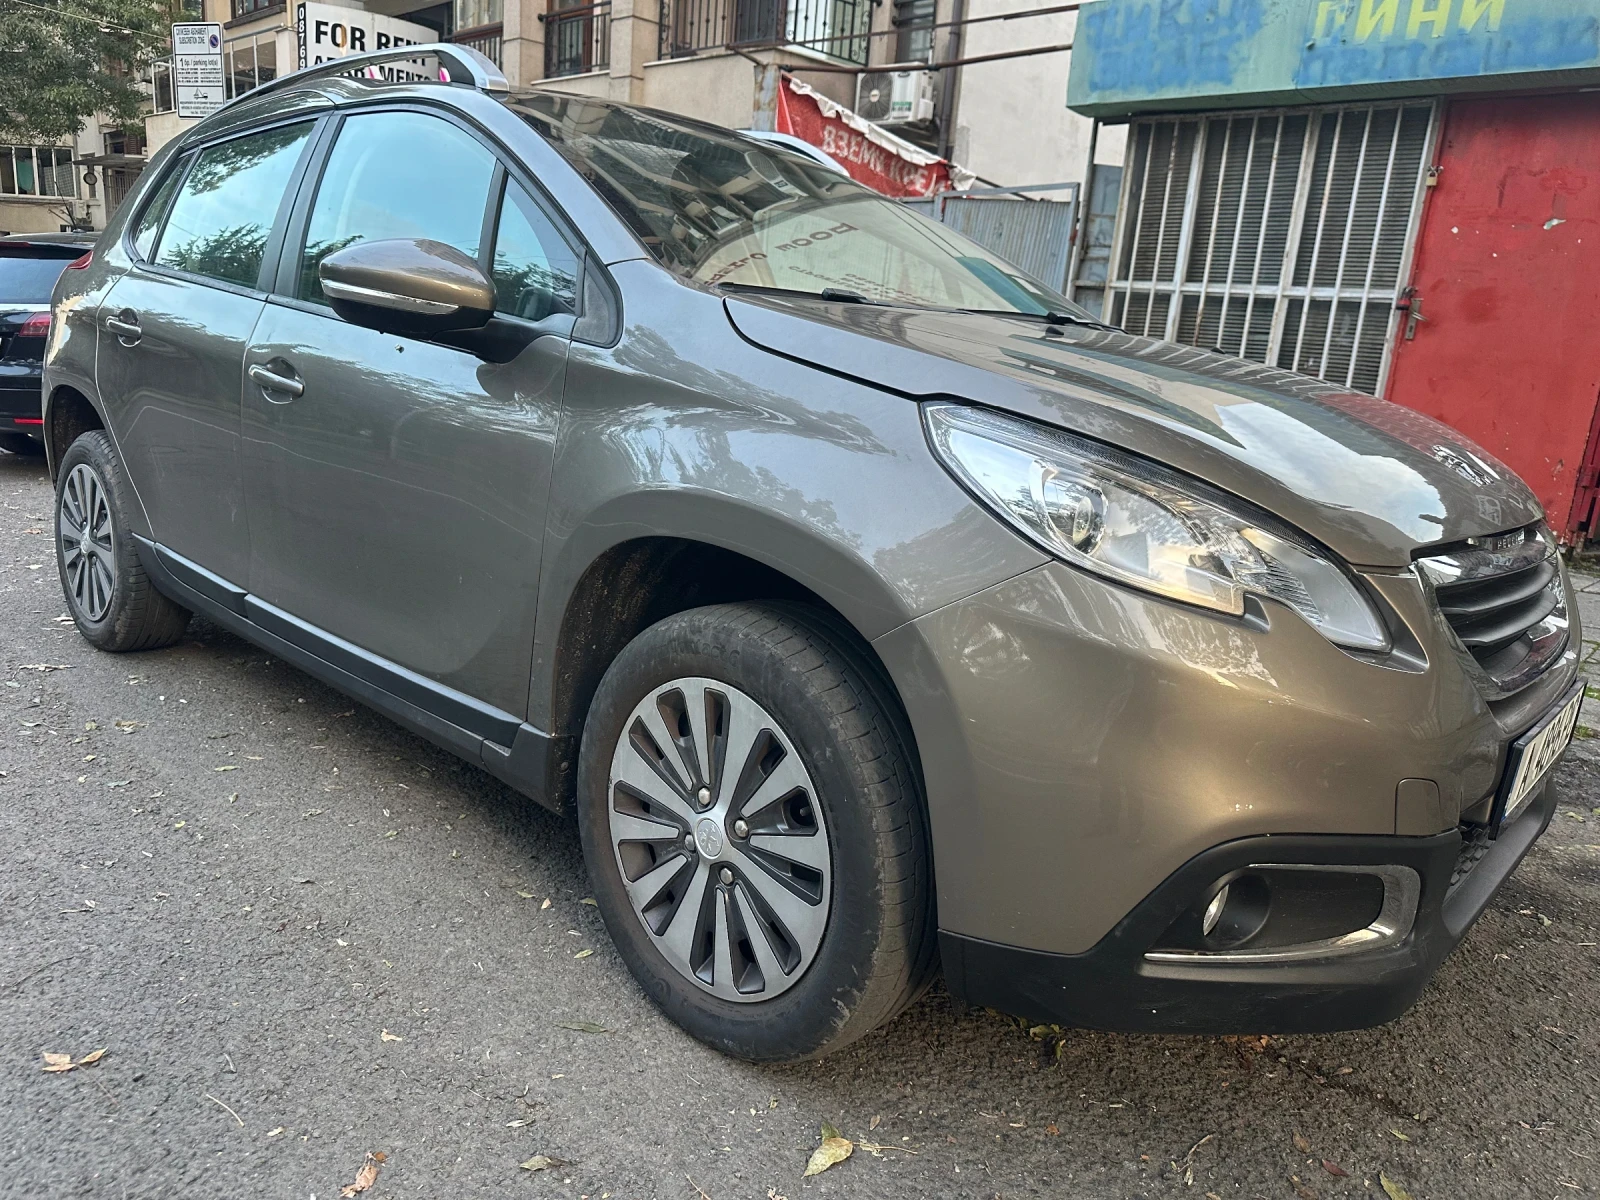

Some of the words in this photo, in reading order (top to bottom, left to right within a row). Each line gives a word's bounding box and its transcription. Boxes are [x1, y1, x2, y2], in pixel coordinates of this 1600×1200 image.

[197, 36, 205, 45] ZONE
[315, 20, 366, 52] FOR
[179, 58, 184, 67] 1
[193, 58, 208, 67] parking
[822, 125, 886, 173] ВЗЕМИ
